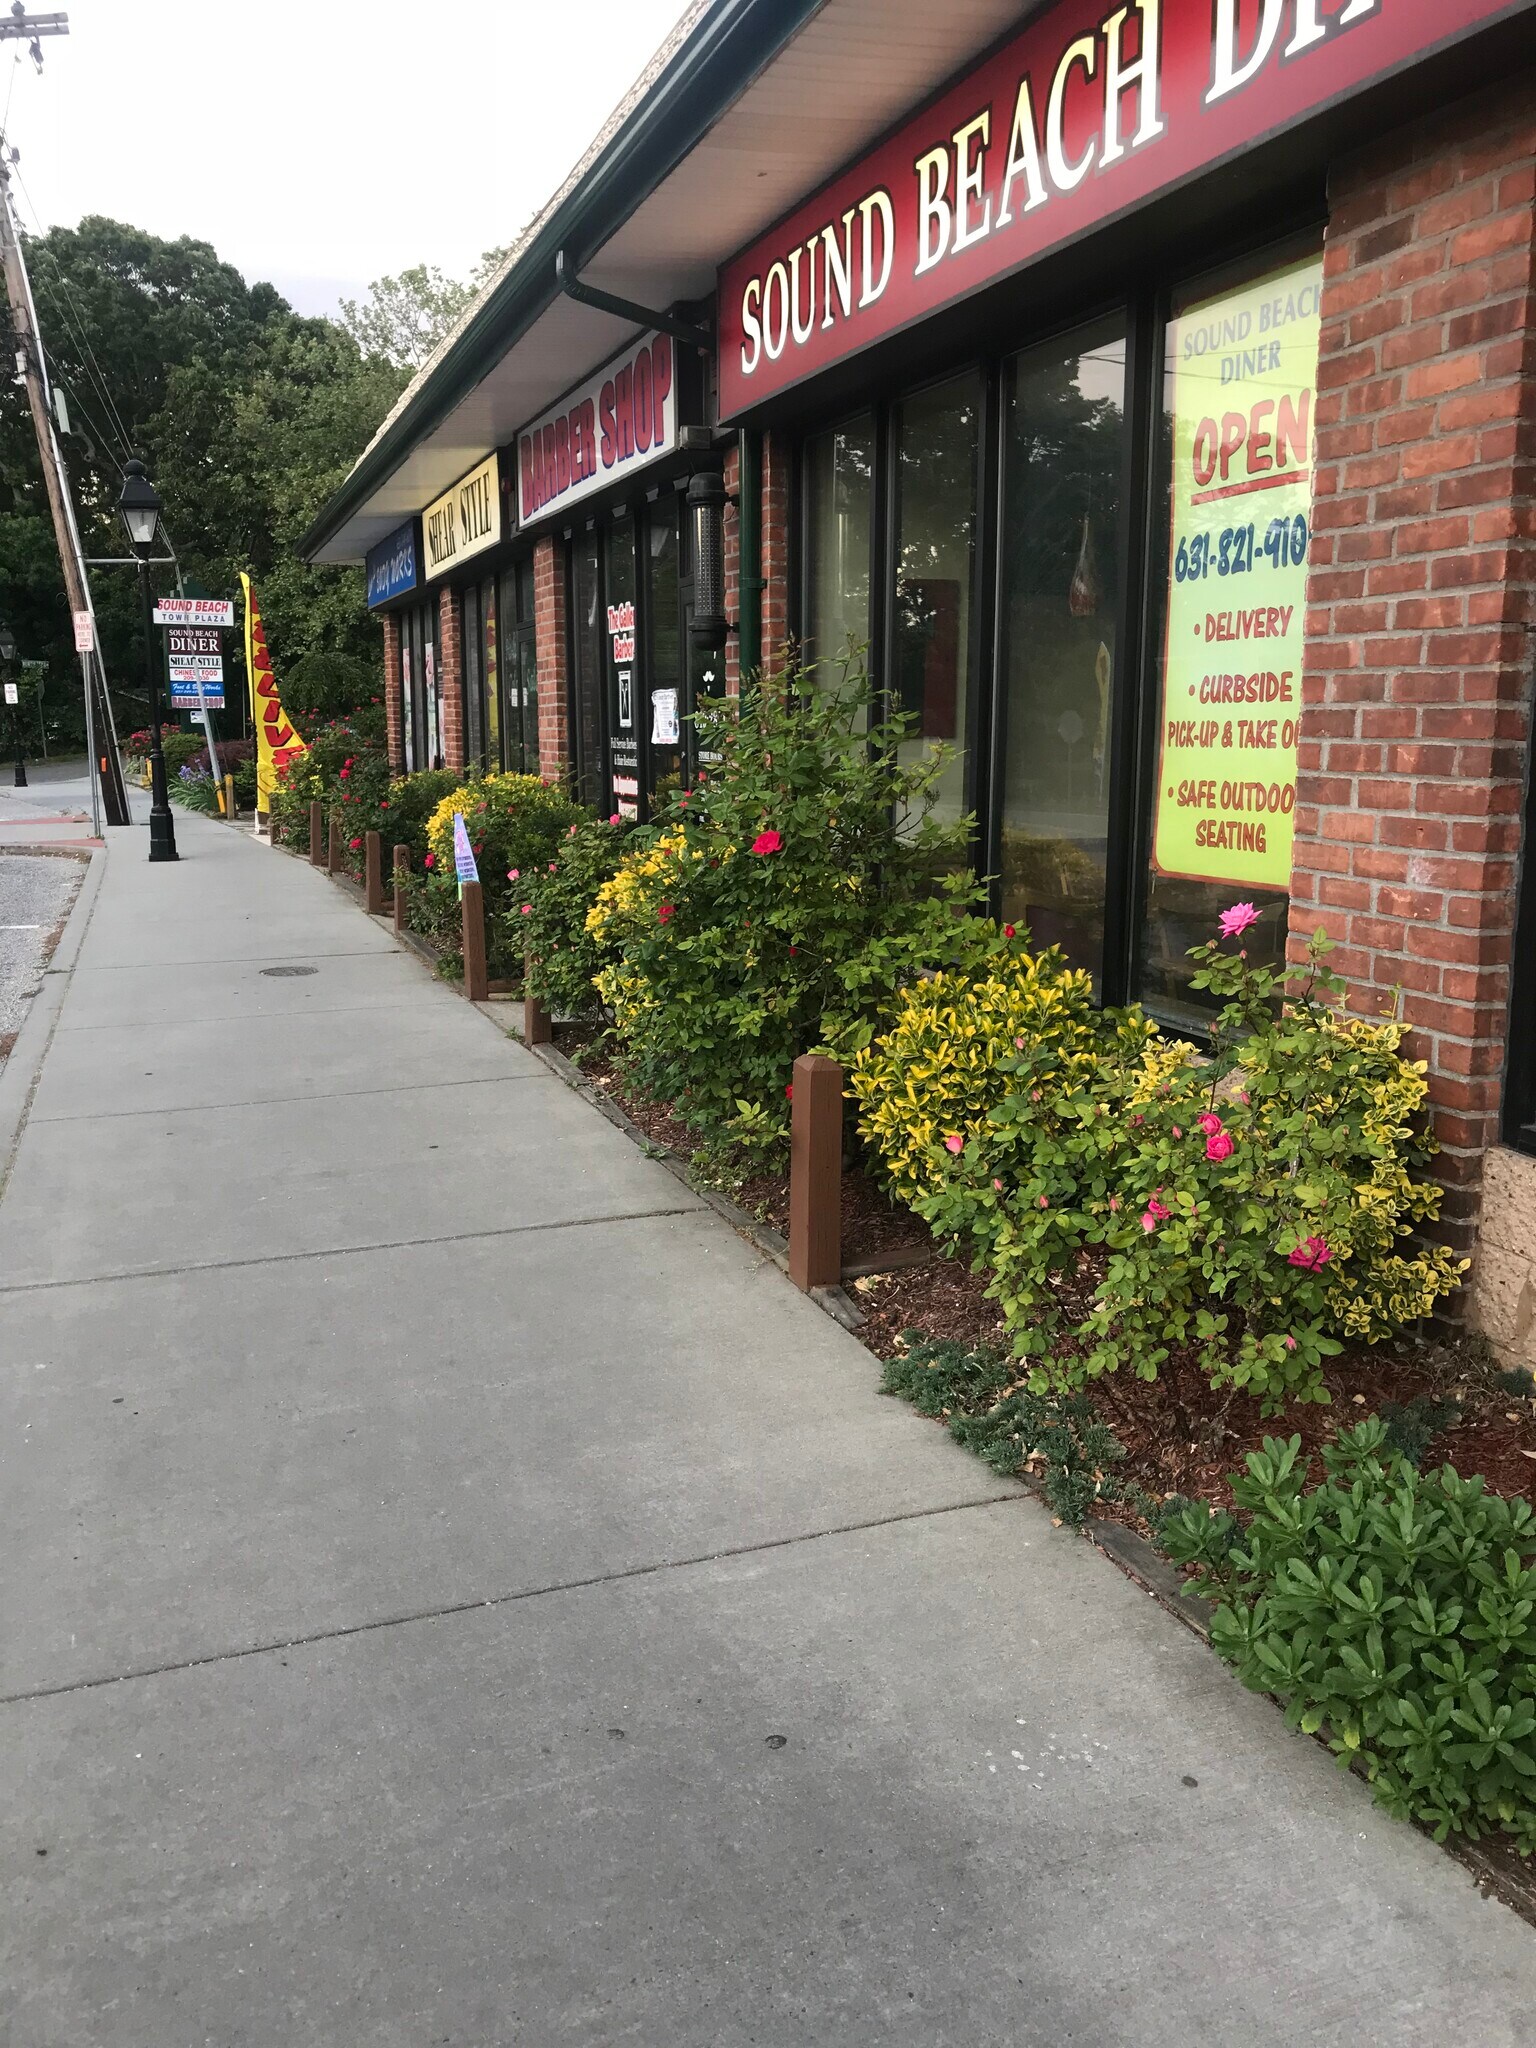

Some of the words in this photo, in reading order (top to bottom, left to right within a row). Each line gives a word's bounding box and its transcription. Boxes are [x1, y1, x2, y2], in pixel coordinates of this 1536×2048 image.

[739, 189, 896, 377] SOUND
[913, 0, 1164, 277] BEACH
[1184, 310, 1251, 361] SOUND
[1220, 340, 1281, 386] DINER
[521, 397, 597, 521] BARBER
[600, 332, 672, 469] SHOP
[1193, 388, 1311, 486] OPEN
[429, 501, 457, 568] SHEAR
[460, 471, 492, 546] STYLE
[1175, 513, 1311, 583] 631-821-910
[158, 600, 192, 612] SOUND
[195, 601, 229, 613] BEACH
[1205, 605, 1293, 642] DELIVERY
[169, 629, 193, 637] SOUND
[195, 630, 218, 638] BEACH
[170, 638, 219, 652] DINER
[198, 658, 221, 667] STYLE
[1199, 671, 1293, 704] CURBSIDE
[1168, 720, 1219, 748] PICK-UP
[1222, 720, 1233, 748] &
[1237, 719, 1278, 749] TAKE
[1177, 779, 1216, 808] SAFE
[1195, 819, 1266, 853] SEATING
